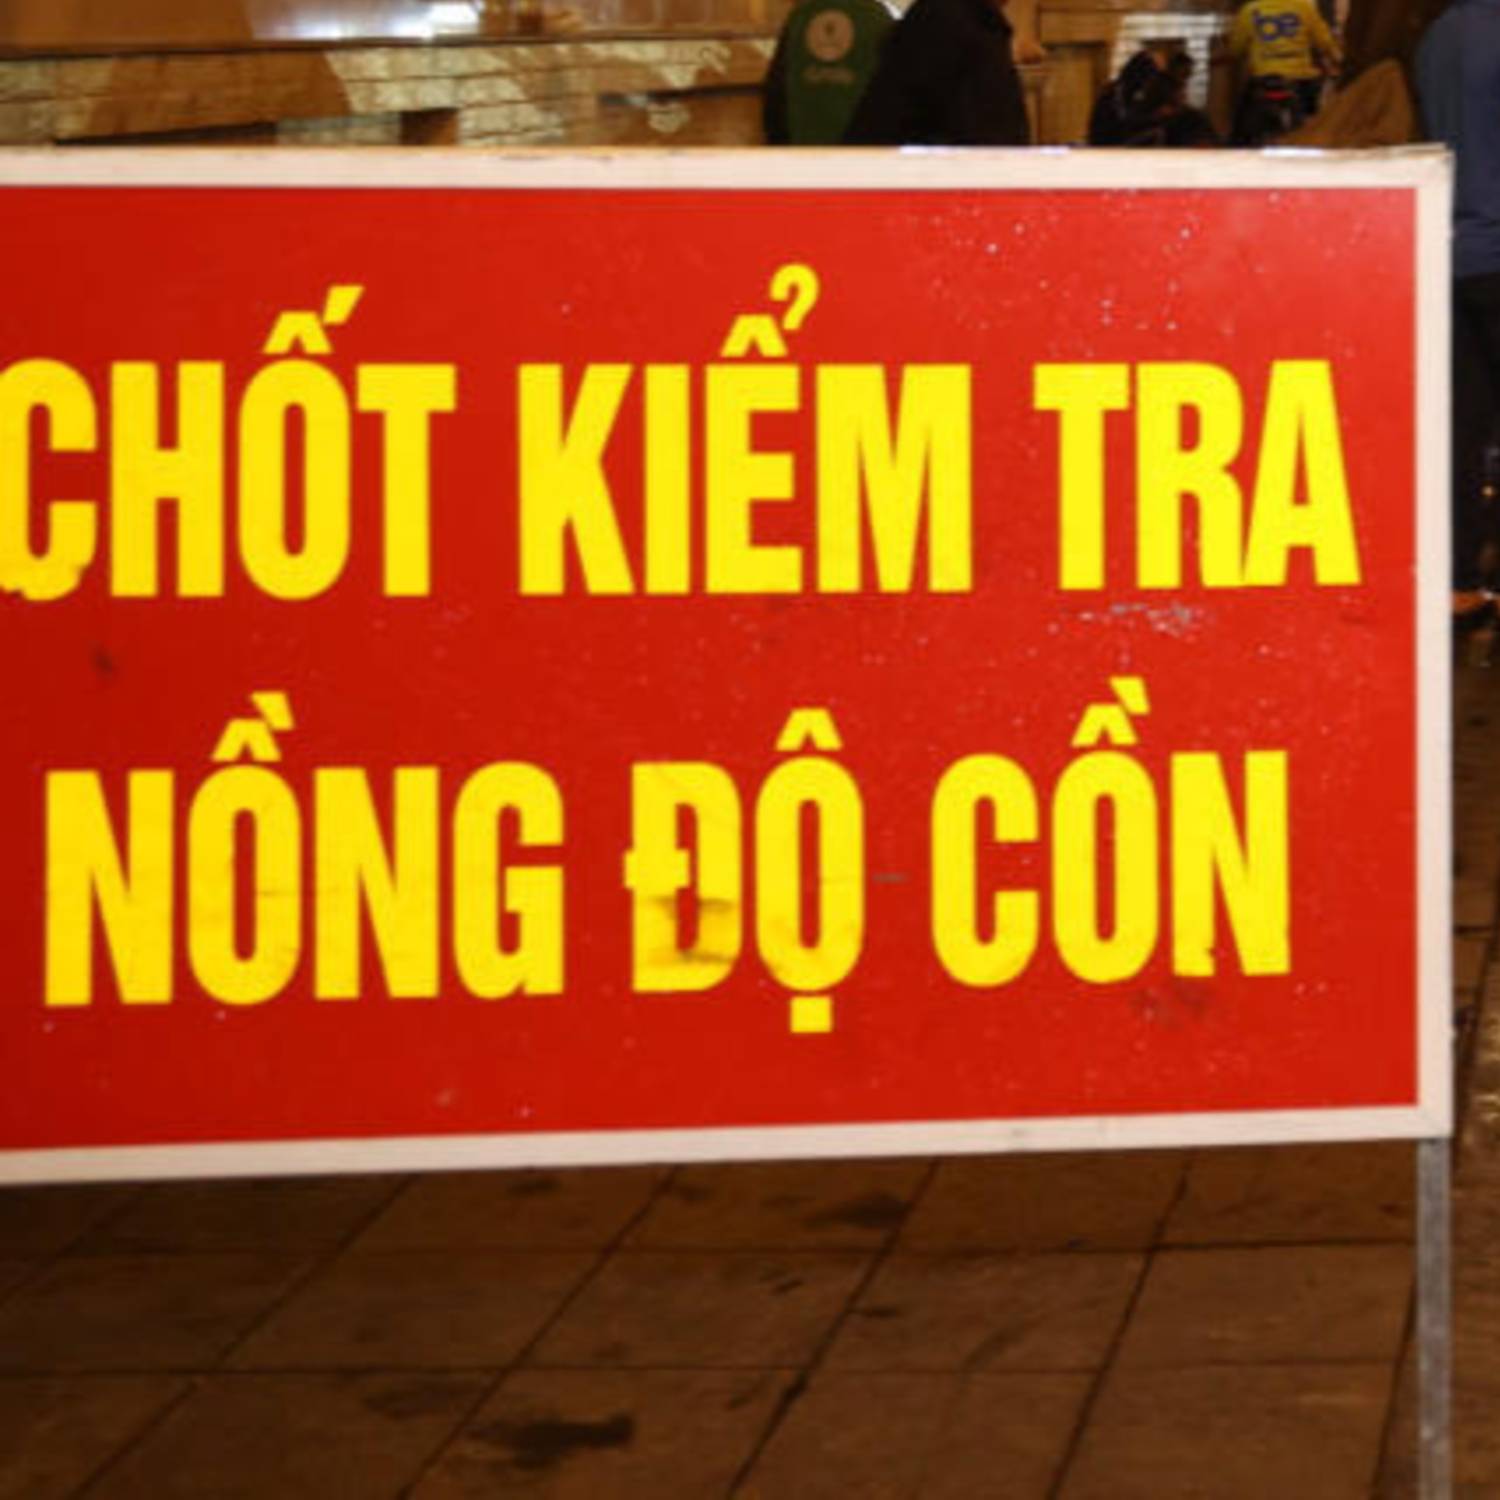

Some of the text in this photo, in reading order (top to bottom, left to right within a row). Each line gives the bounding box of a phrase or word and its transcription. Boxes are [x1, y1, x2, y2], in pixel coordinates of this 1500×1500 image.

[1252, 7, 1301, 43] be
[0, 263, 1362, 602] CHỐT KIỂM TRA
[44, 675, 1291, 1034] NỒNG ĐỘ CỒN
